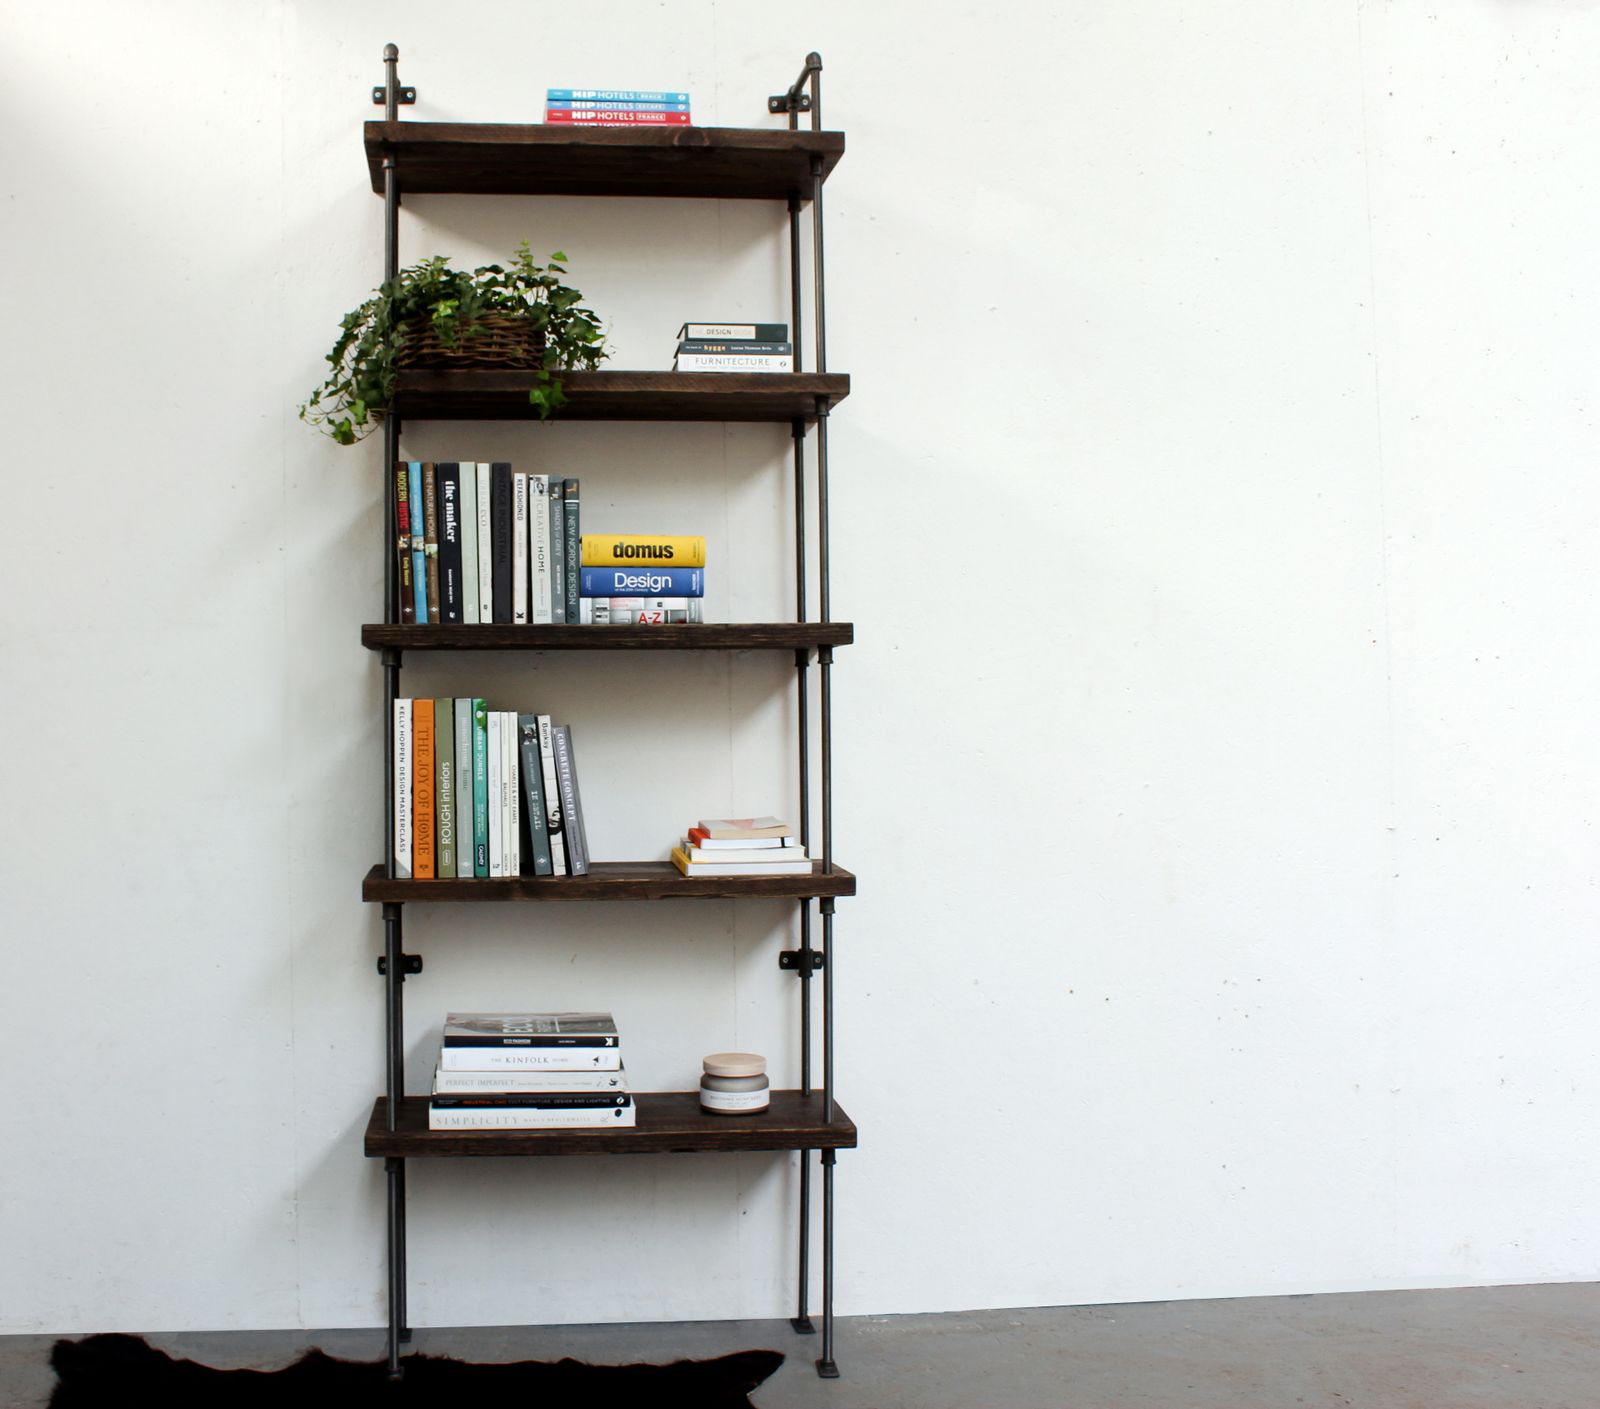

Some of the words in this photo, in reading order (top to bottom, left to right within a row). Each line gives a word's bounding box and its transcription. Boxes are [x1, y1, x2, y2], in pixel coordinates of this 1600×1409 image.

[597, 102, 634, 110] HOTELS
[598, 91, 634, 100] HOTELS
[572, 111, 596, 119] HIP
[597, 112, 634, 120] HOTELS
[696, 358, 769, 366] FURNITECTURE
[397, 471, 407, 501] MODERN
[445, 481, 456, 500] the
[426, 485, 434, 514] NATURAL
[399, 502, 408, 528] RUSTIC
[446, 502, 455, 542] maker
[568, 515, 576, 535] NEW
[498, 509, 507, 564] INDUSTRIAL
[568, 538, 576, 570] NORDIC
[613, 543, 673, 559] domus
[568, 572, 576, 605] DESIGN
[615, 573, 671, 592] Design
[639, 612, 661, 624] A-Z
[417, 727, 429, 757] THE
[542, 723, 551, 749] Banksy
[557, 733, 571, 780] CONCRETE
[417, 760, 429, 786] JOY
[441, 762, 451, 802] interiors
[462, 769, 470, 791] home
[418, 789, 429, 809] OF
[563, 781, 576, 821] CONCEPT
[418, 813, 429, 855] HOME
[441, 804, 451, 844] ROUGH
[436, 1116, 518, 1125] SIMPLICITY
